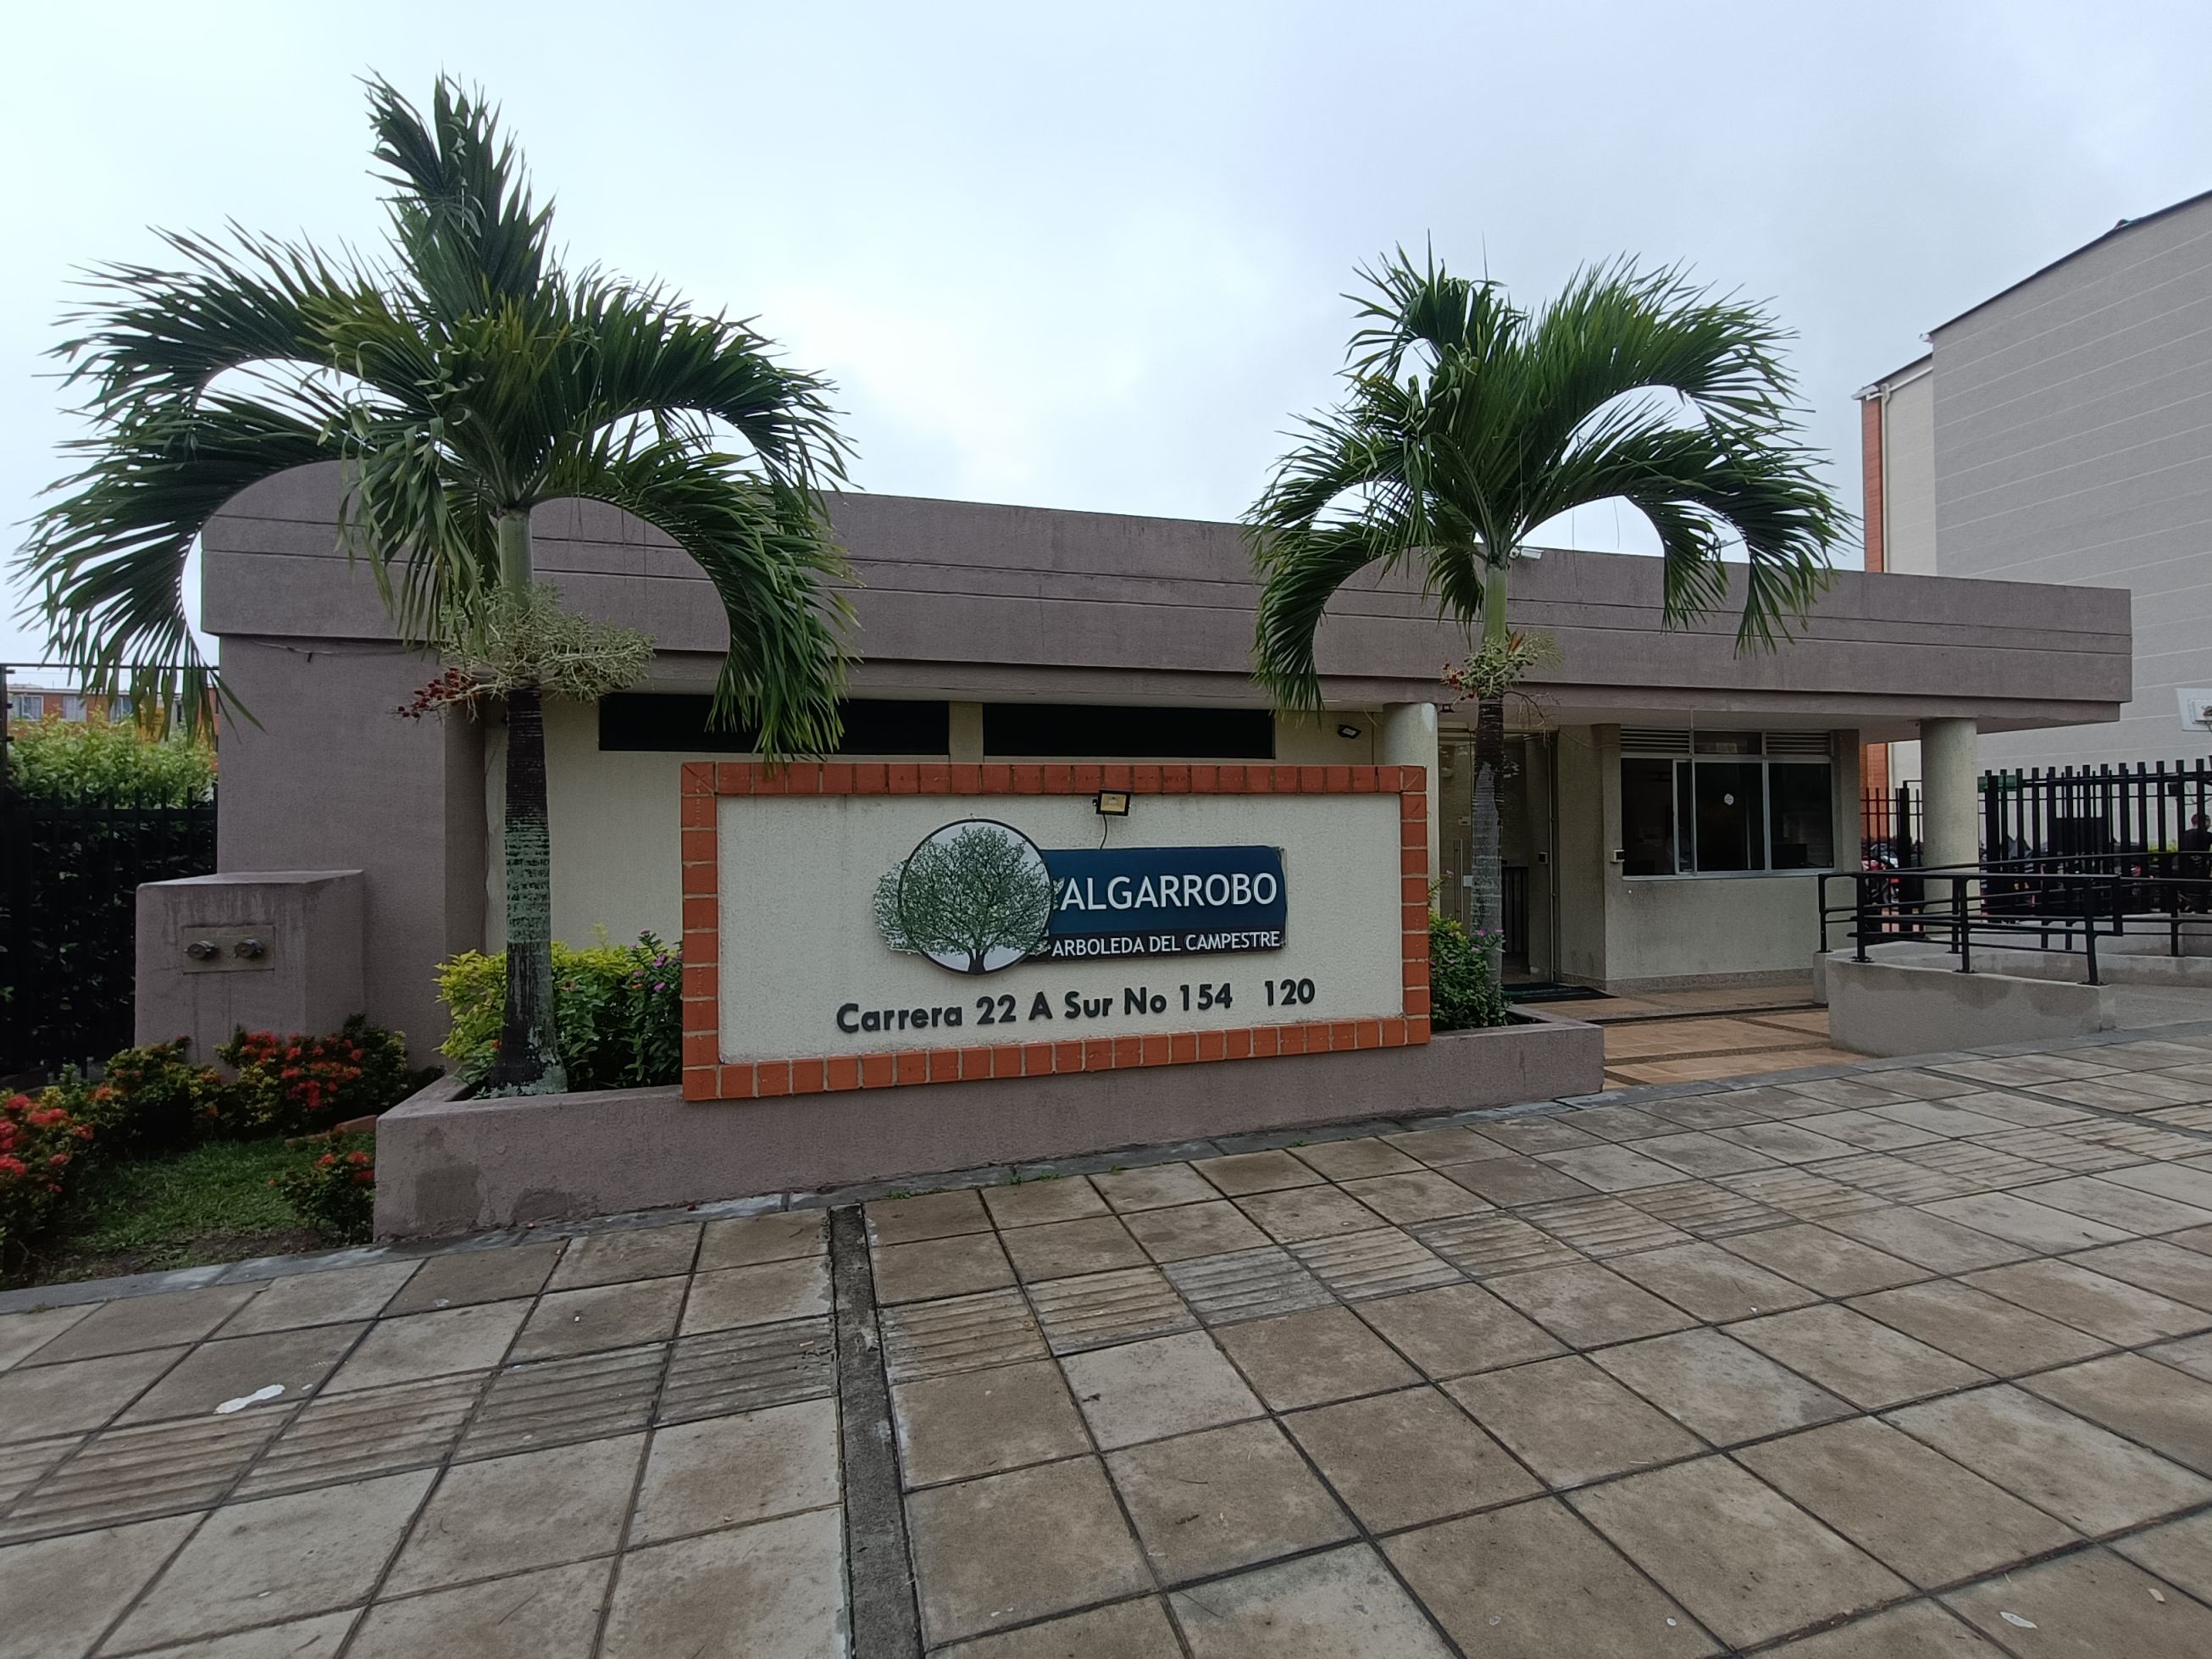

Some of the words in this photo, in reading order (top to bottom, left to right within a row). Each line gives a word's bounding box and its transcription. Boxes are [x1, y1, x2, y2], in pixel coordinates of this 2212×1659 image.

[1060, 873, 1277, 911] ALGARROBO
[1051, 937, 1145, 957] ARBOLEDA
[1149, 935, 1181, 952] DEL
[1185, 930, 1280, 951] CAMPESTRE
[836, 1002, 962, 1033] Carrera
[976, 994, 1017, 1024] 22
[1028, 990, 1053, 1020] A
[1064, 990, 1112, 1018] Sur
[1124, 986, 1167, 1015] No
[1180, 983, 1233, 1011] 154
[1264, 978, 1315, 1007] 120
